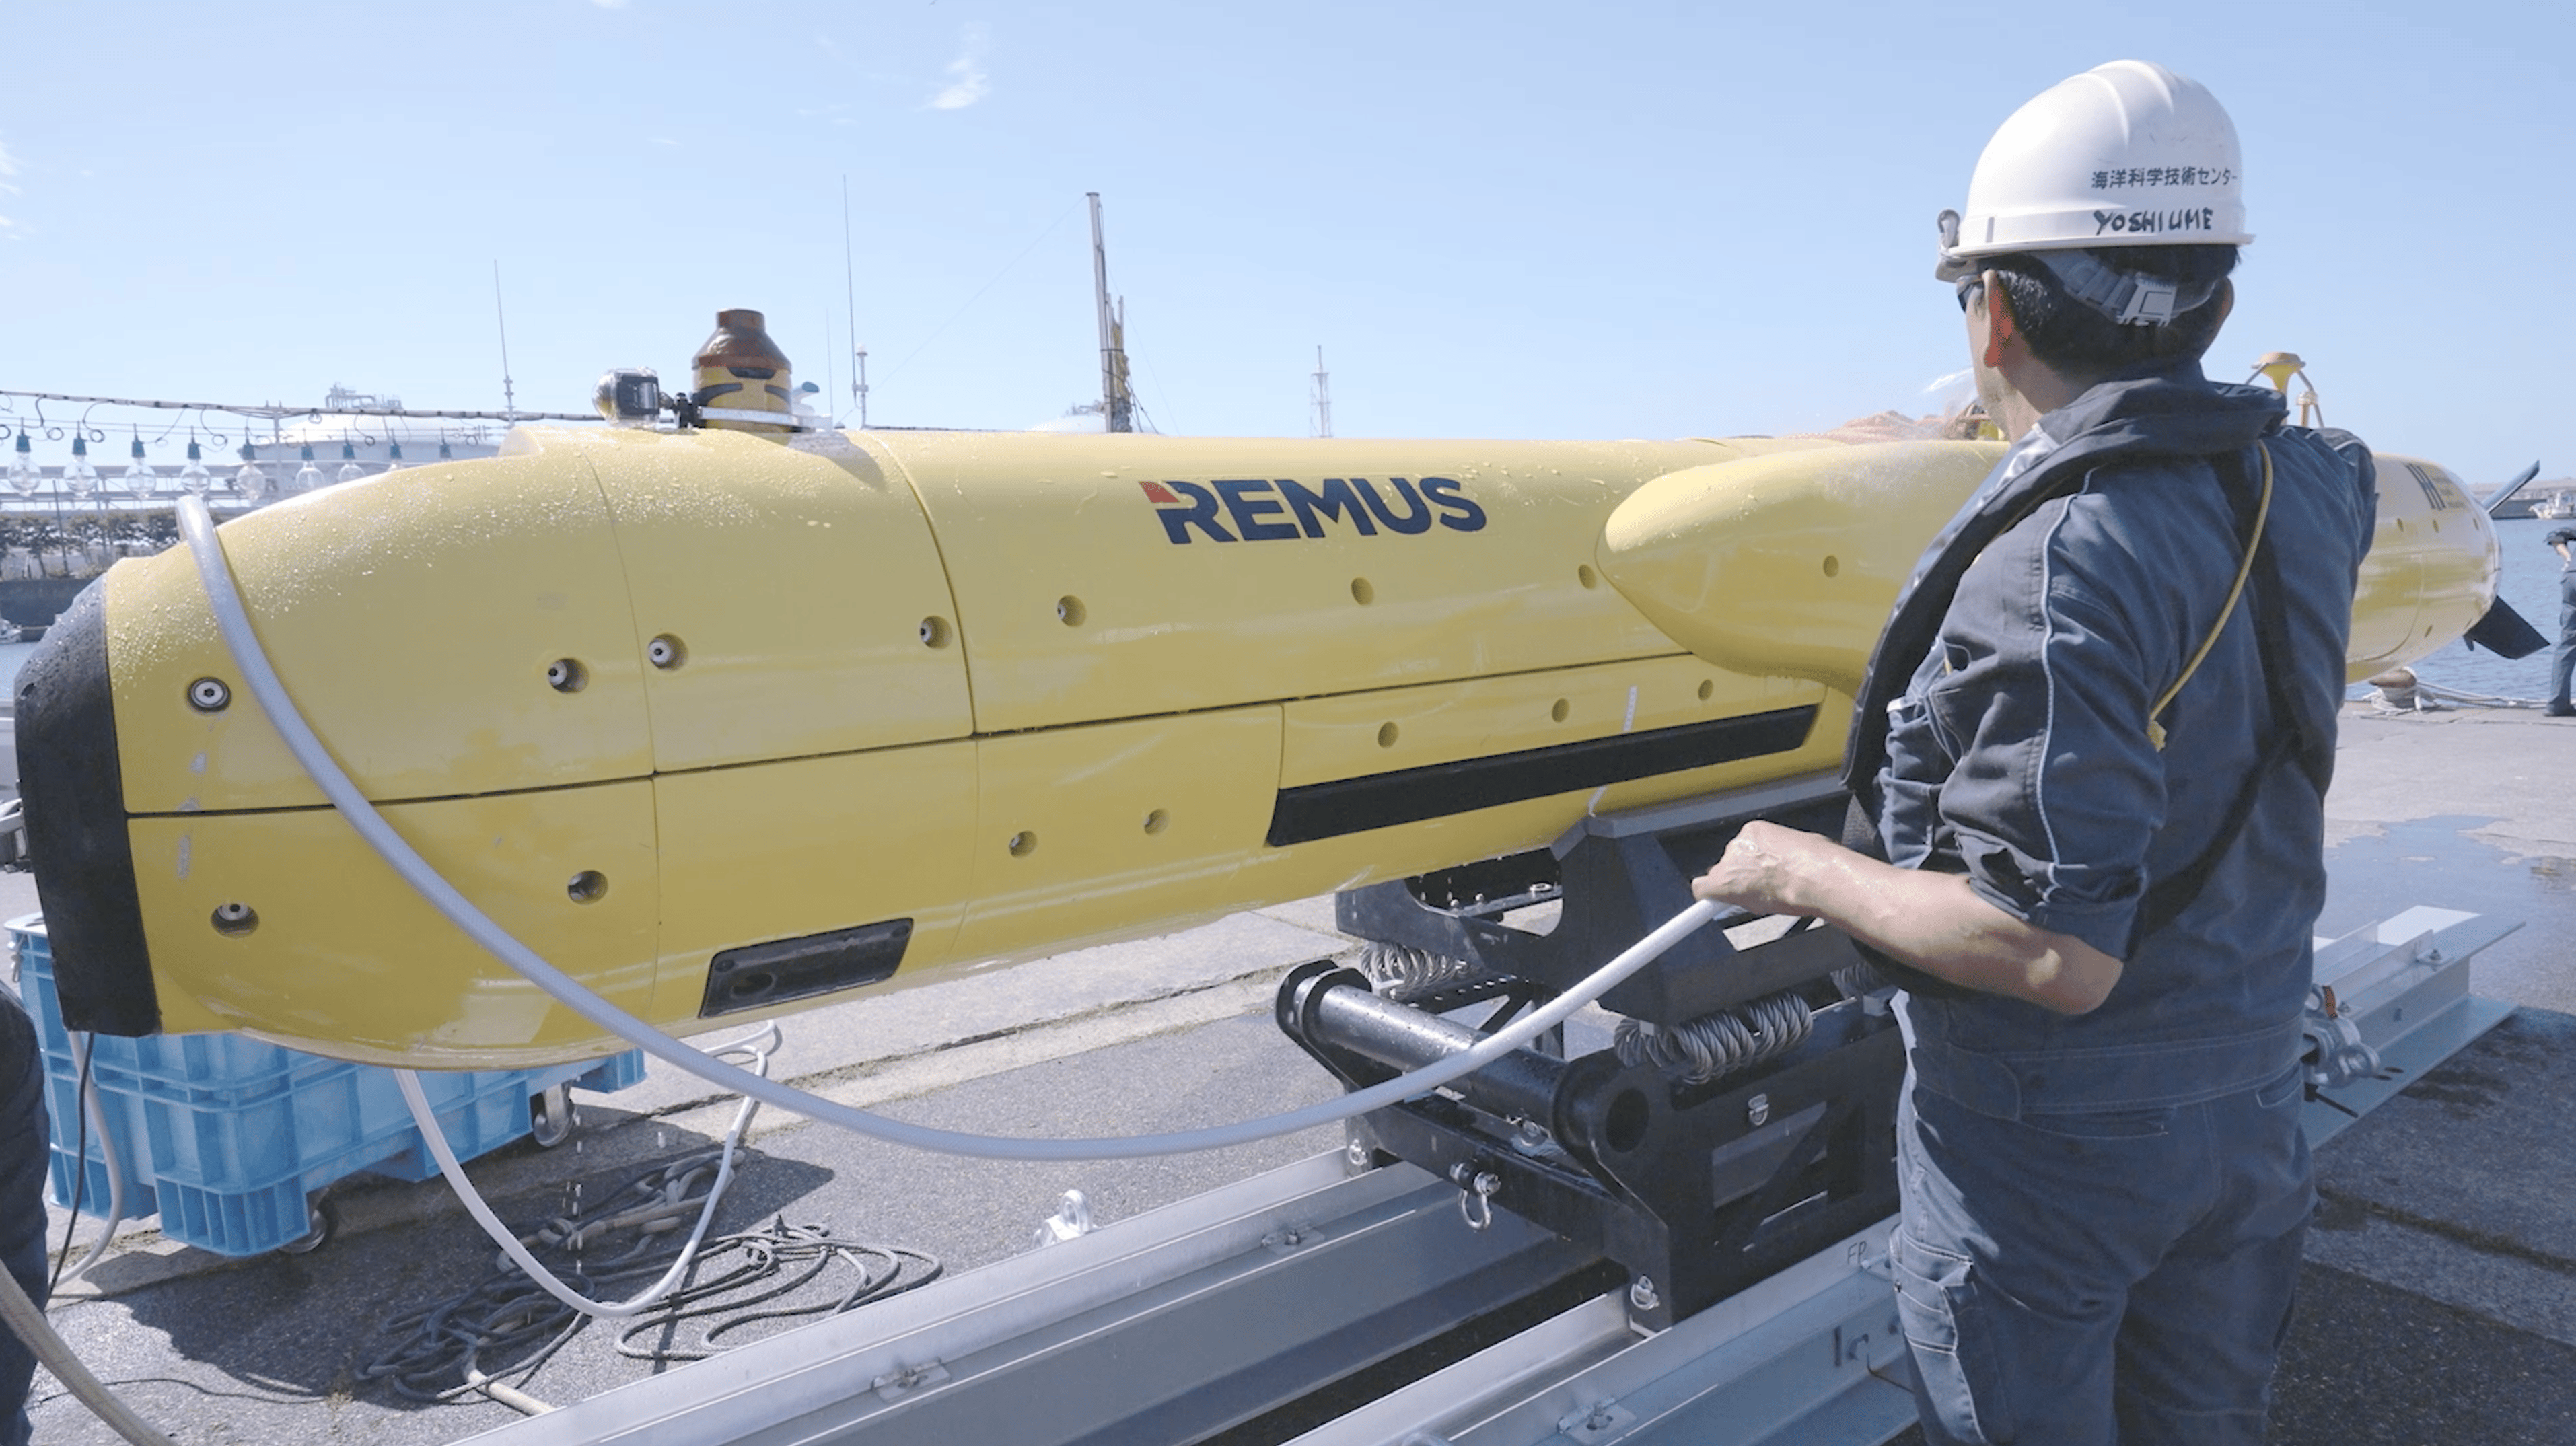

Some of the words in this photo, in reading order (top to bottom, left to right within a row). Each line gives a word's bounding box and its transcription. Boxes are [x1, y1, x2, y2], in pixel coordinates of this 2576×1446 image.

[2091, 166, 2238, 189] 海洋科学技術センター
[1138, 477, 1487, 544] REMUS
